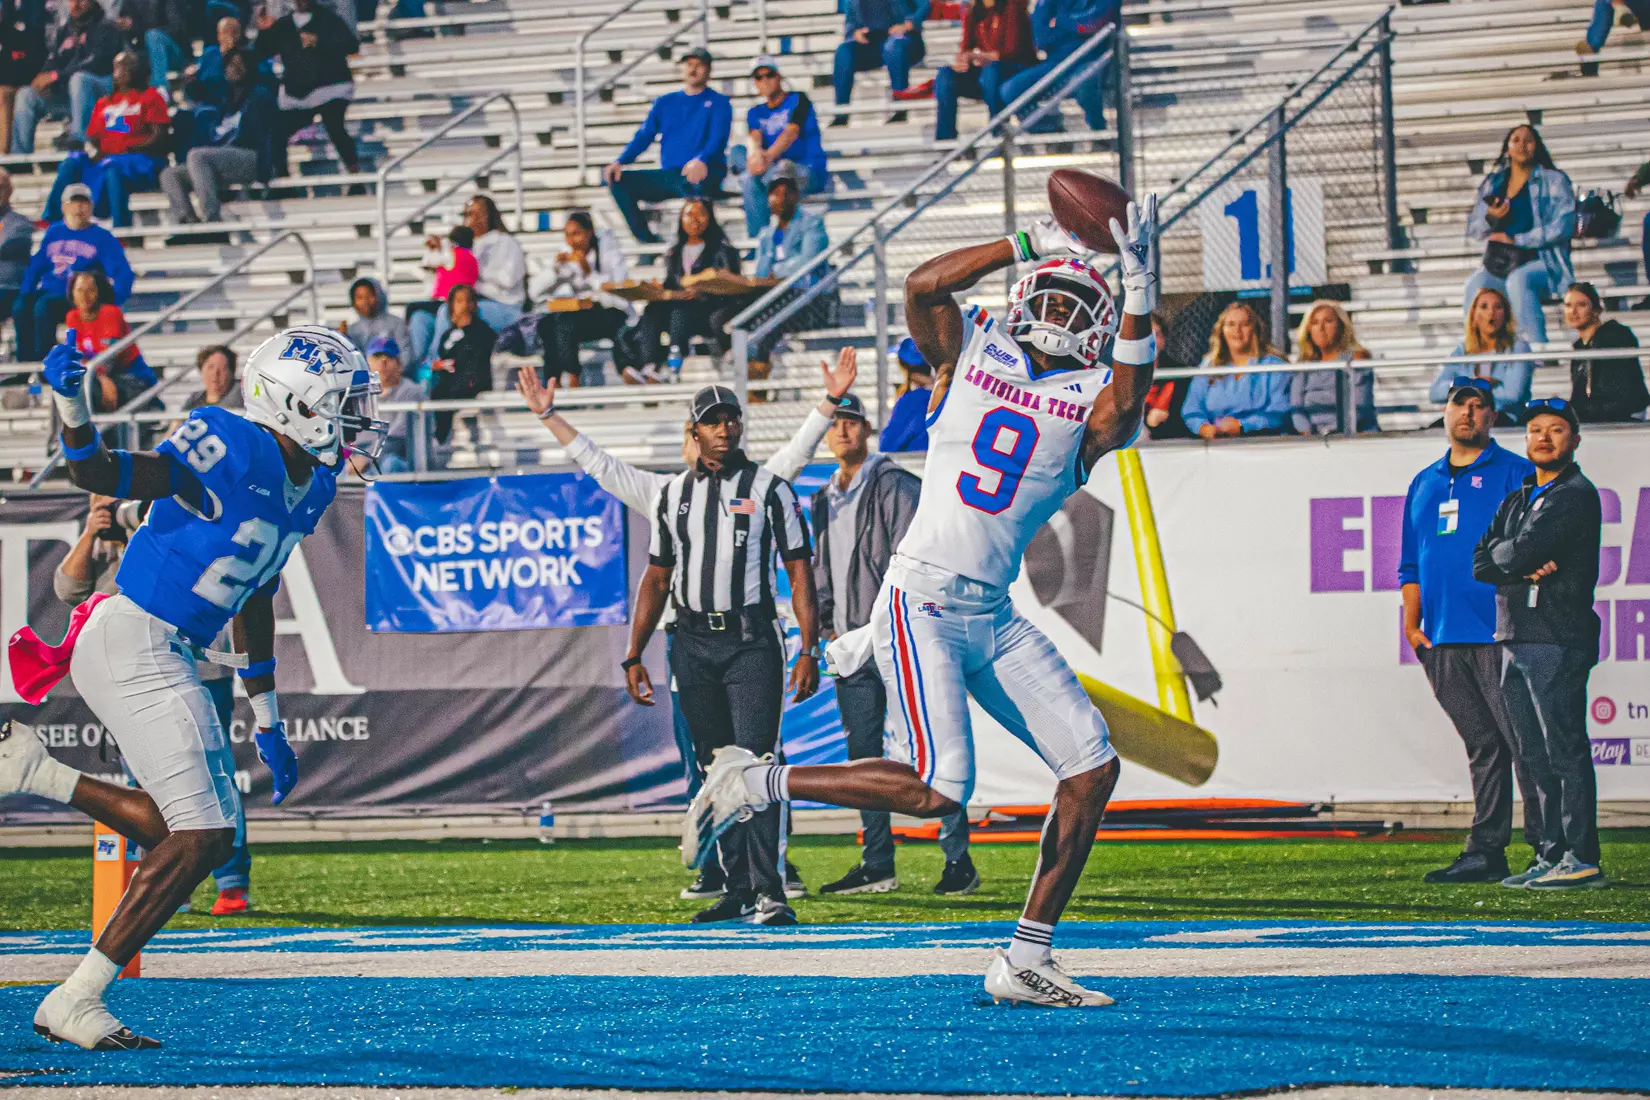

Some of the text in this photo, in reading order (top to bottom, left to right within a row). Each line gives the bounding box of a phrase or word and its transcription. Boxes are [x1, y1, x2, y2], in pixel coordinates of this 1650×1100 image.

[964, 363, 1087, 423] LOUISIANA TECH
[169, 418, 227, 473] 29
[956, 405, 1040, 515] 9
[679, 502, 690, 515] S
[415, 515, 604, 556] CBS SPORTS
[735, 529, 748, 547] F
[412, 554, 583, 592] NETWORK
